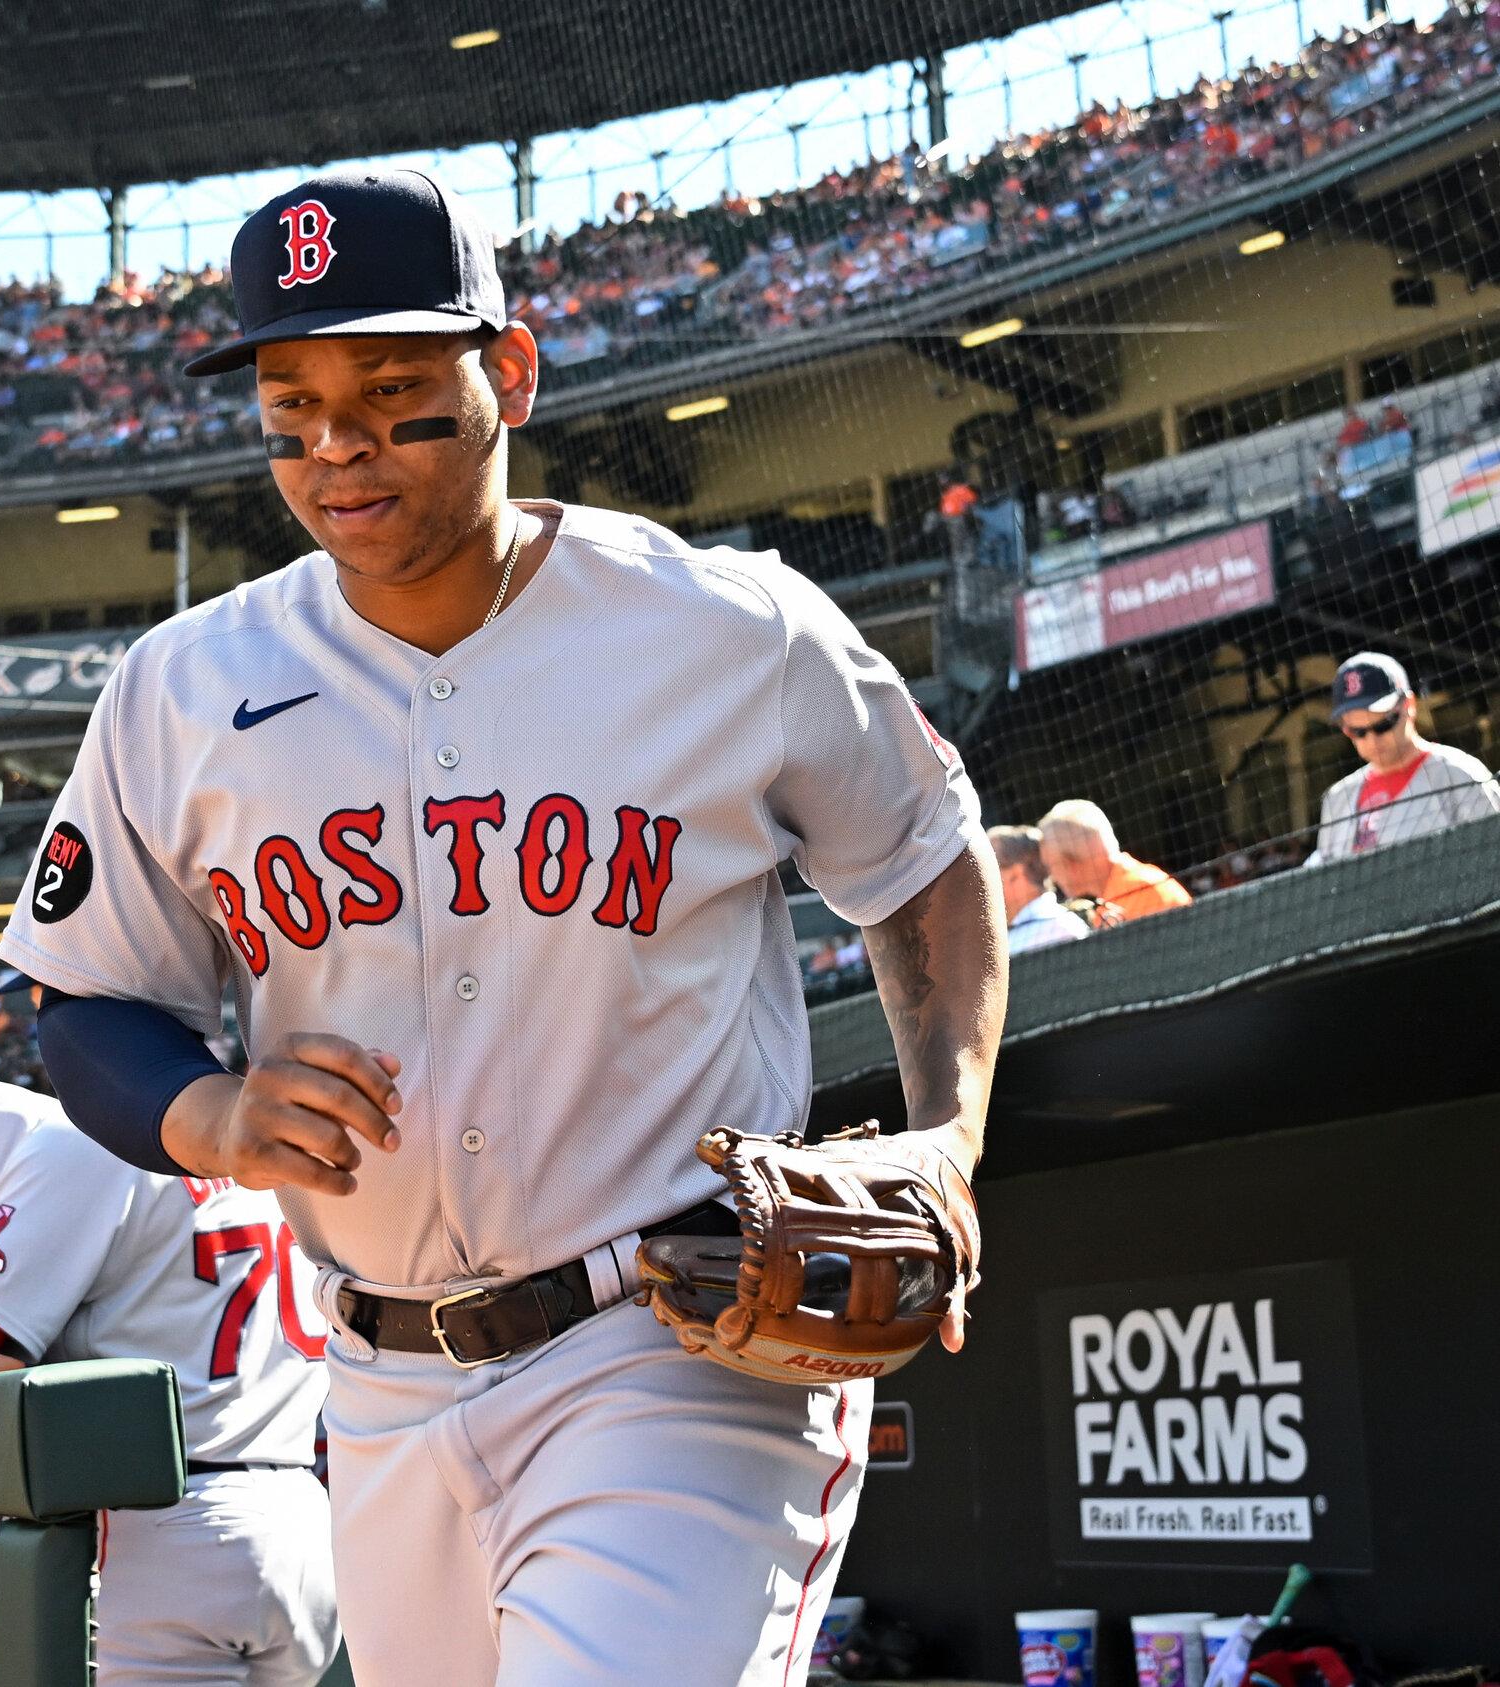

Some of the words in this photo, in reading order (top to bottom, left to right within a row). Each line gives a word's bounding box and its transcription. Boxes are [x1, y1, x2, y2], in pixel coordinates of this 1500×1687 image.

[278, 199, 338, 290] B
[35, 863, 64, 912] 2
[47, 830, 82, 871] REMY
[208, 789, 683, 980] BOSTON
[194, 1221, 328, 1381] 70
[782, 1353, 886, 1376] A2000
[1069, 1298, 1302, 1396] ROYAL
[1074, 1391, 1308, 1486] FARMS
[1088, 1505, 1131, 1531] Real
[1136, 1505, 1193, 1532] Fresh.
[1201, 1505, 1245, 1531] Real
[1252, 1506, 1302, 1532] Fast.
